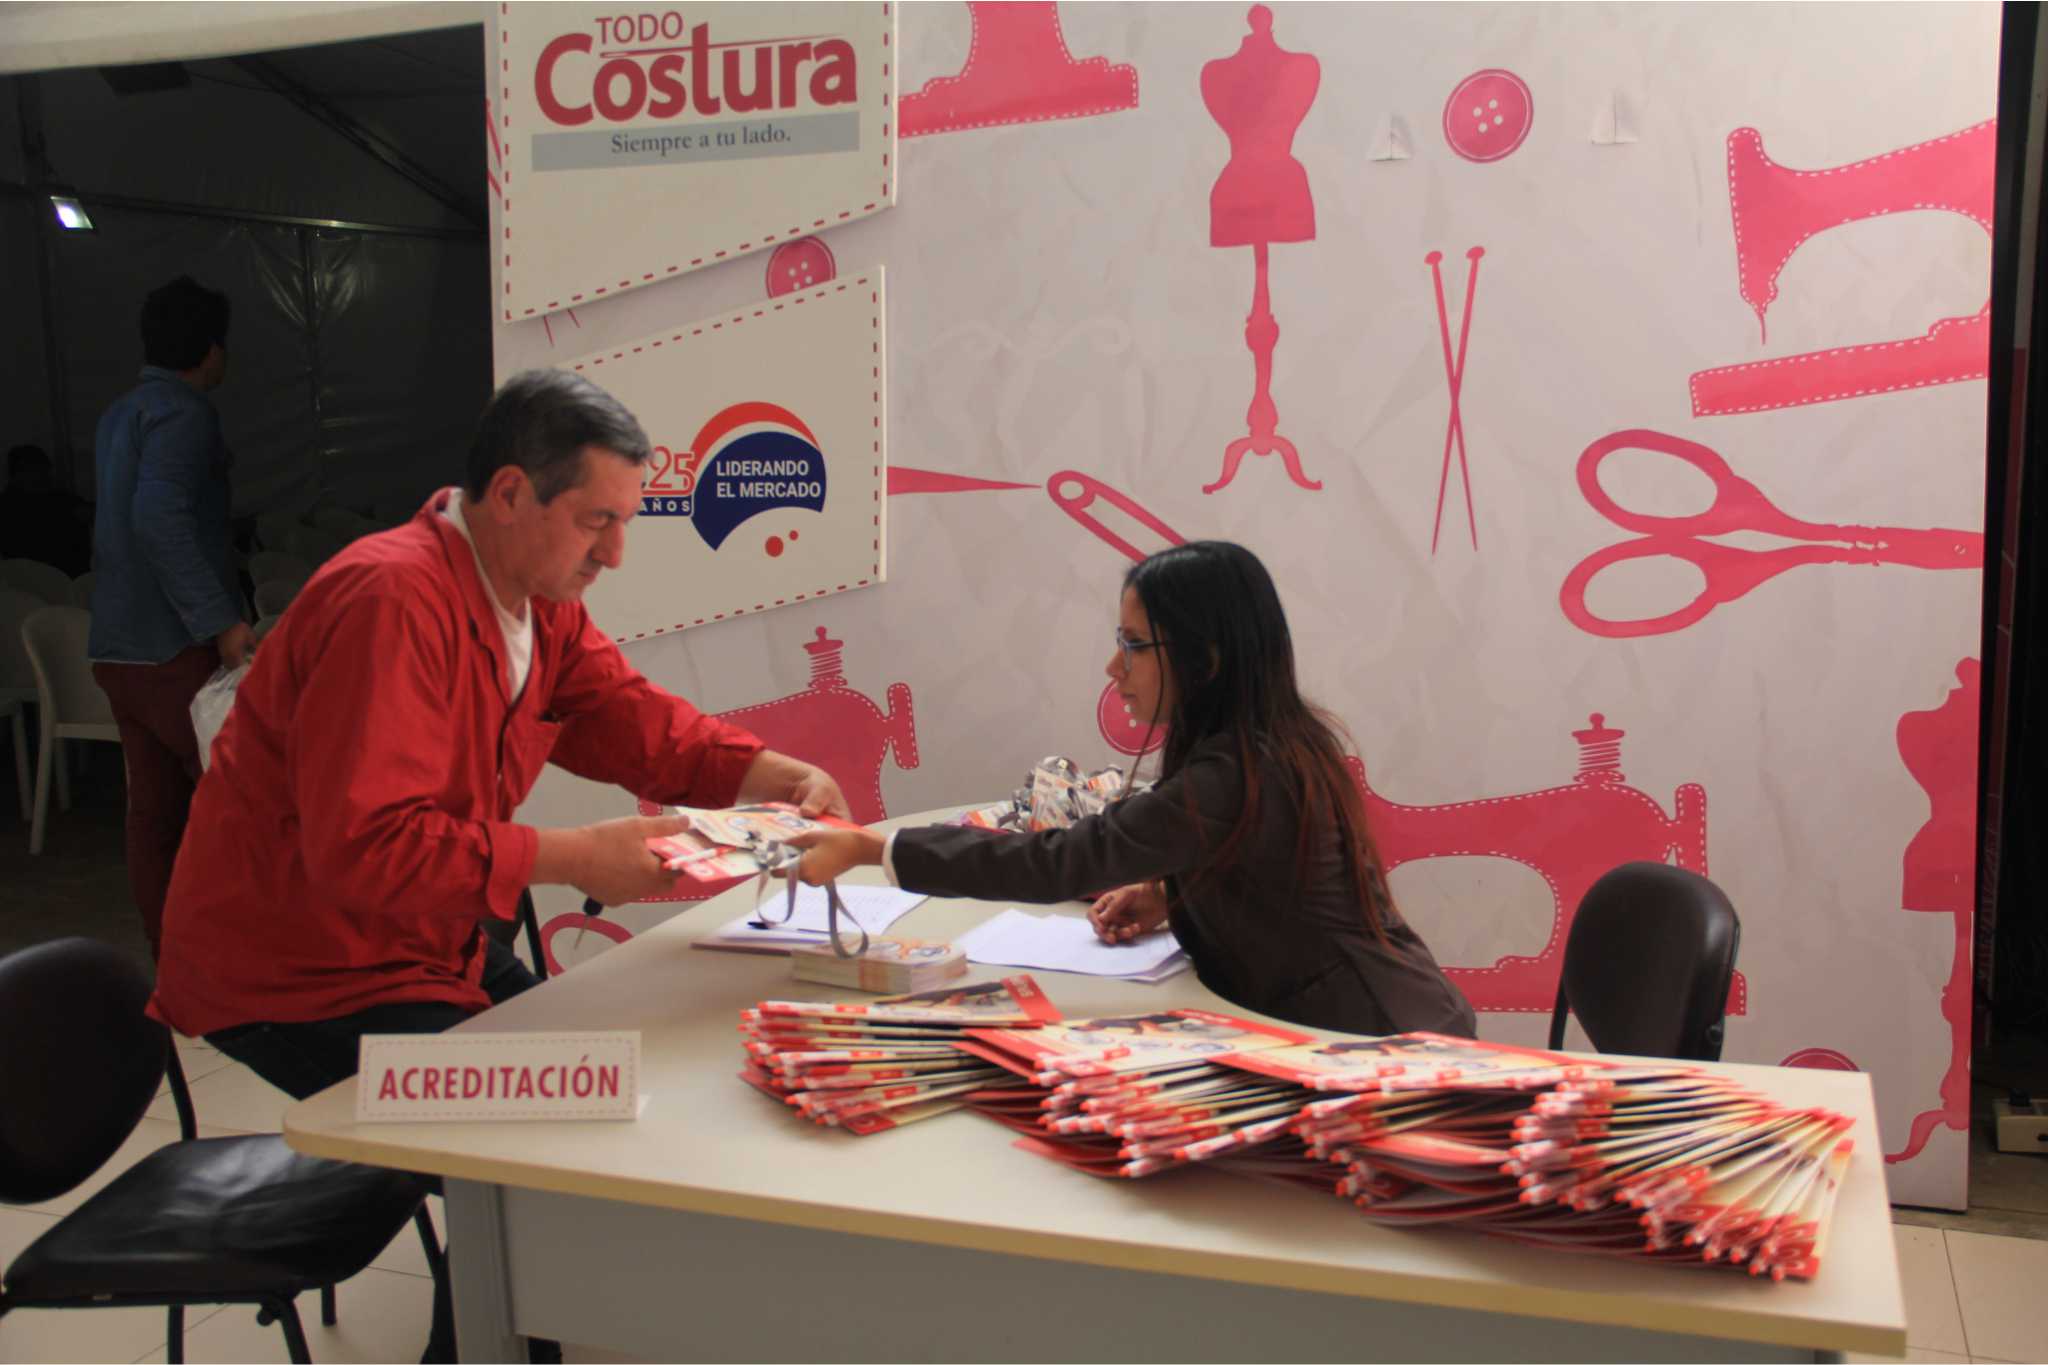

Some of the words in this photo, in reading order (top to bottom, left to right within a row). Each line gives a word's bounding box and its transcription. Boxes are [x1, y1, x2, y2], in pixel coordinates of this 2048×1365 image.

[595, 12, 684, 45] TODO
[534, 22, 858, 126] Costura
[611, 133, 692, 157] Siempre
[699, 134, 710, 148] a
[717, 131, 736, 146] tu
[742, 124, 791, 144] lado.
[648, 446, 696, 495] 25
[716, 460, 810, 477] LIDERANDO
[716, 481, 736, 498] EL
[740, 481, 821, 498] MERCADO
[378, 1054, 619, 1100] ACREDITACIÓN
